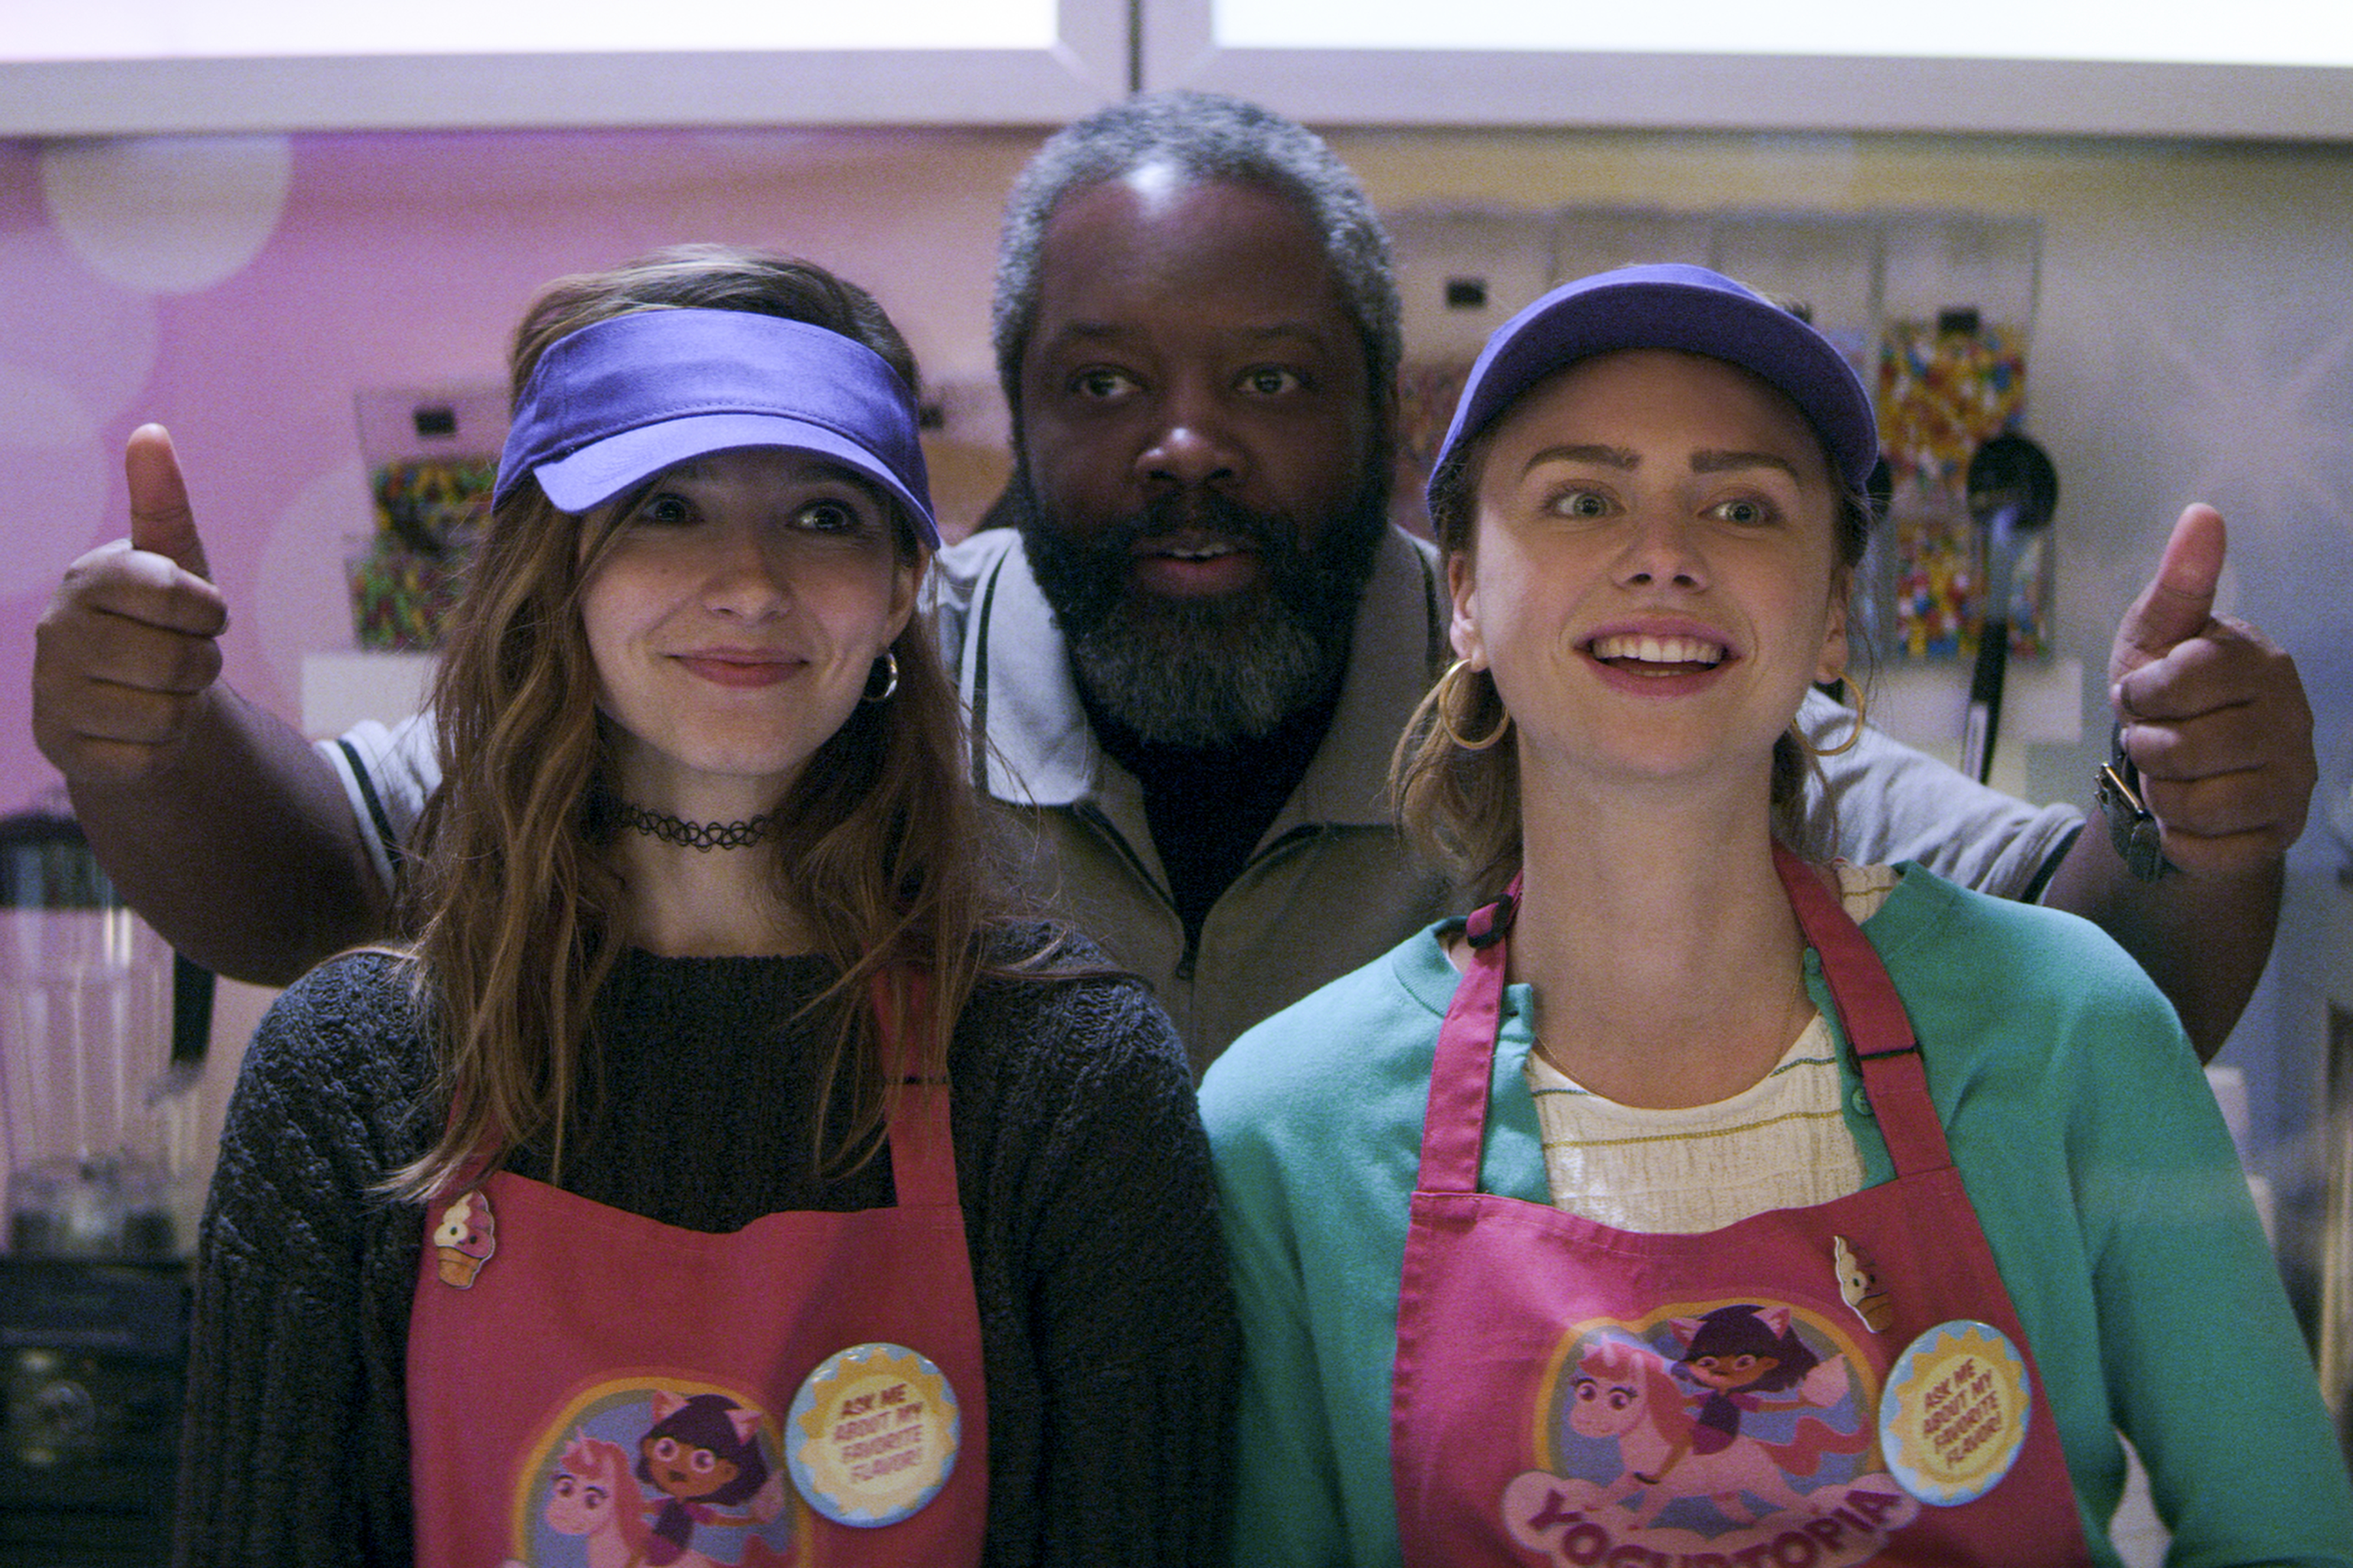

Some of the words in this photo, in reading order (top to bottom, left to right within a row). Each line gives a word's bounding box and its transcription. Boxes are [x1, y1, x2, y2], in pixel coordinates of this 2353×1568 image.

[841, 1393, 875, 1418] ASK
[880, 1383, 907, 1407] ME
[1923, 1388, 1966, 1439] ABOUT
[1971, 1368, 1992, 1401] MY
[1924, 1377, 1952, 1413] ASK
[1953, 1358, 1976, 1387] ME
[895, 1401, 924, 1424] MY
